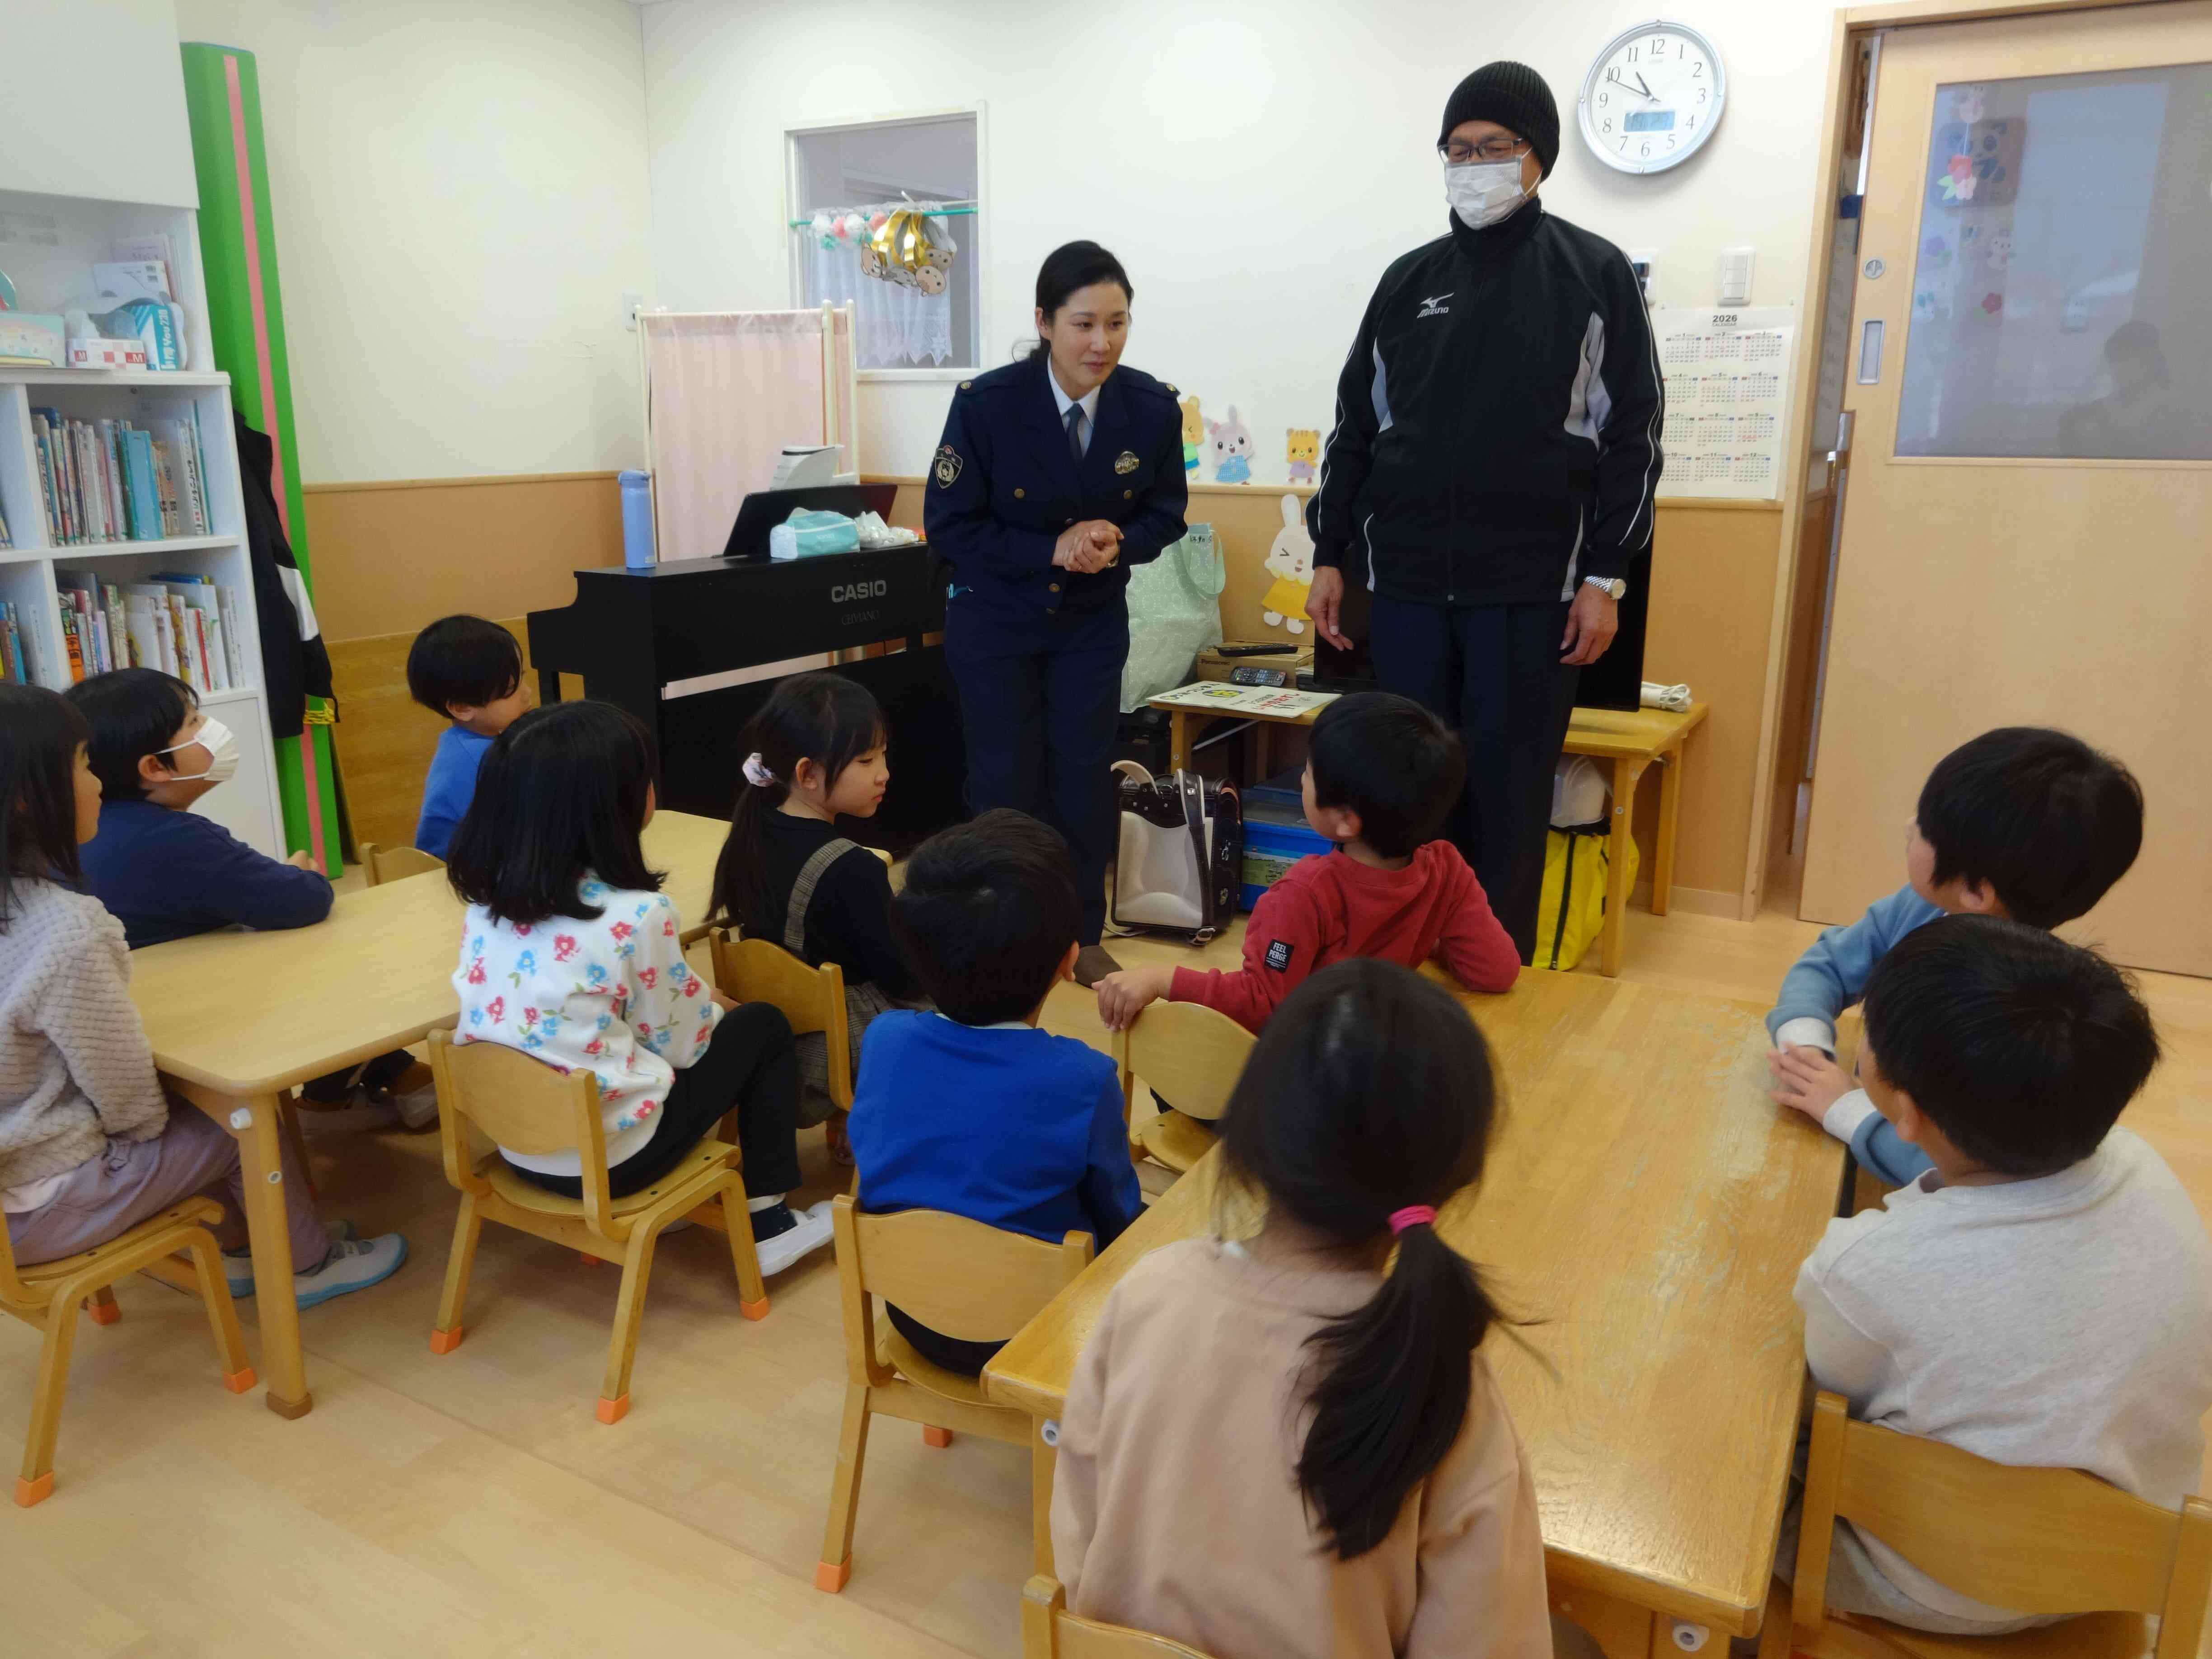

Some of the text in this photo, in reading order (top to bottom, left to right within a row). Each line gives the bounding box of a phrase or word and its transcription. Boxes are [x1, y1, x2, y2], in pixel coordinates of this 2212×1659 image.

[1627, 47, 1639, 62] 11
[1650, 39, 1665, 55] 12
[1678, 44, 1684, 59] 1
[1692, 62, 1702, 77] 2
[1599, 93, 1609, 108] 9
[1697, 88, 1706, 104] 3
[1602, 118, 1612, 133] 8
[1686, 114, 1694, 130] 4
[1619, 136, 1628, 152] 7
[1641, 141, 1650, 157] 6
[1666, 134, 1676, 150] 5
[831, 580, 887, 603] CASIO
[1269, 949, 1287, 962] PERGE
[1273, 942, 1286, 954] FEEL
